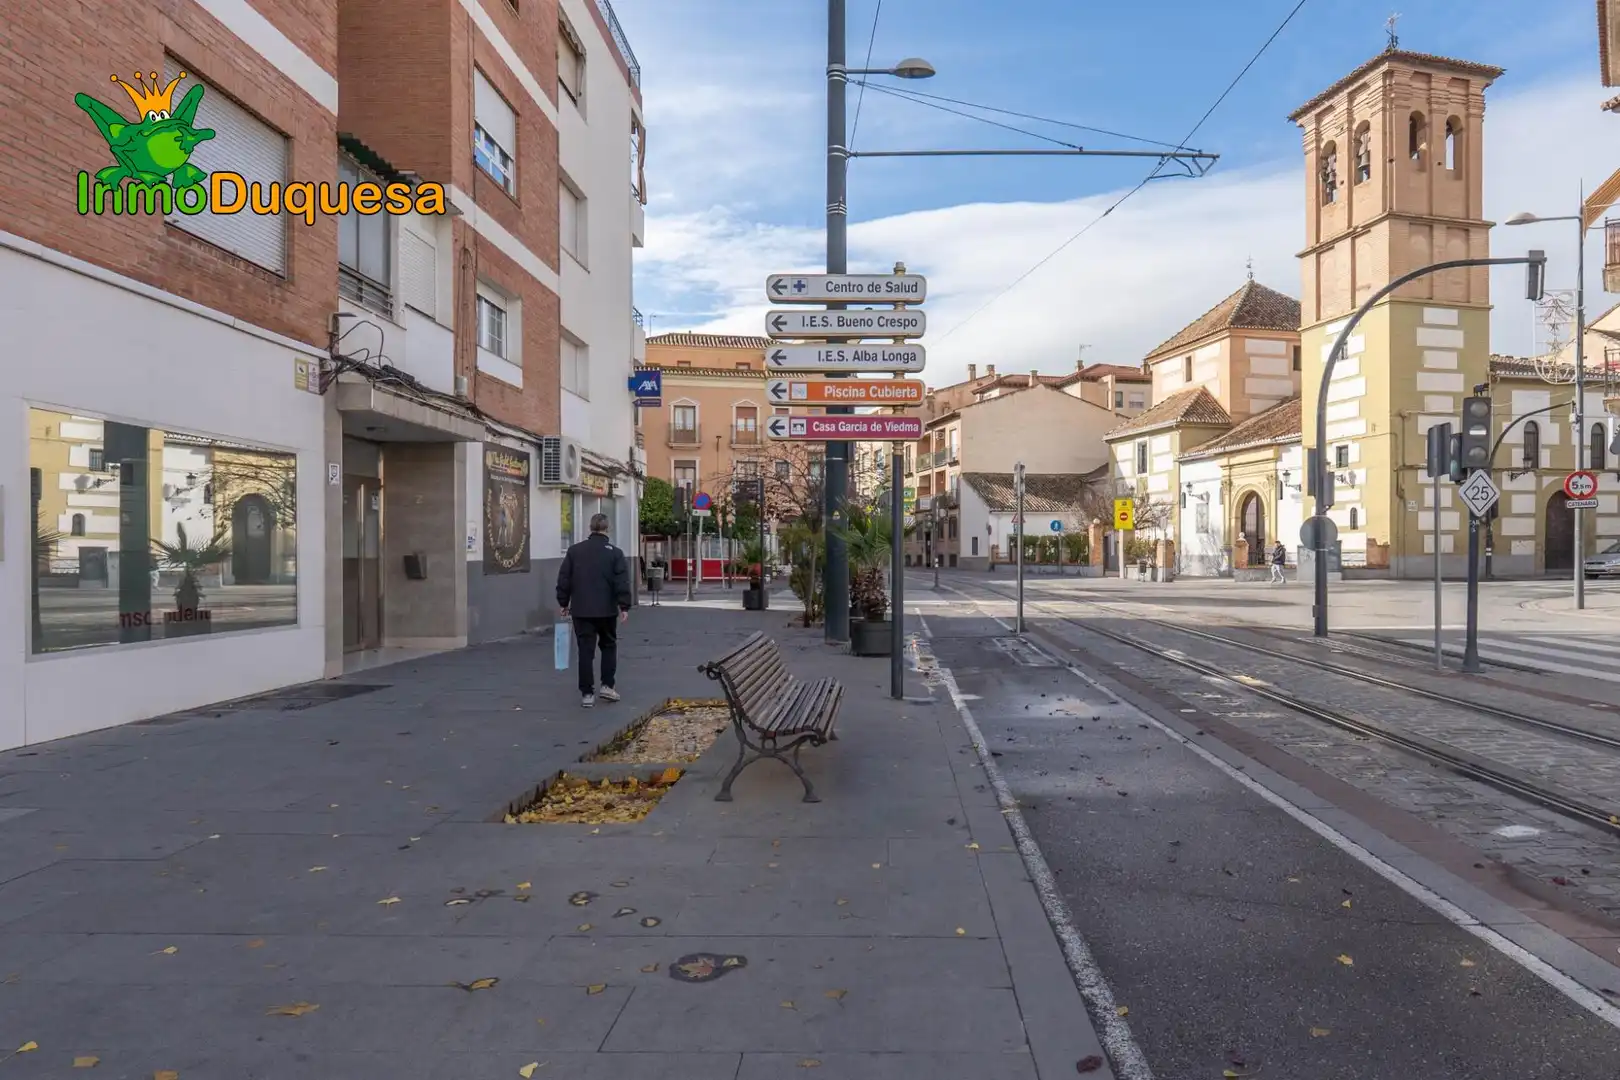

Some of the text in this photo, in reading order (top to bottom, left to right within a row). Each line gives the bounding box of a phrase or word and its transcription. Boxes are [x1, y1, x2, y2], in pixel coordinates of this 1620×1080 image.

[825, 281, 918, 293] Centro de Salud
[802, 316, 918, 329] I.E.S. Bueno Crespo
[818, 350, 917, 364] I.E.S. Alba Longa
[638, 379, 658, 390] AXA
[824, 385, 918, 398] Piscina Cubierta
[812, 421, 836, 432] Casa
[870, 421, 882, 432] de
[884, 421, 919, 432] Viedma
[1471, 486, 1490, 501] 25
[1568, 500, 1596, 508] CATENARIA
